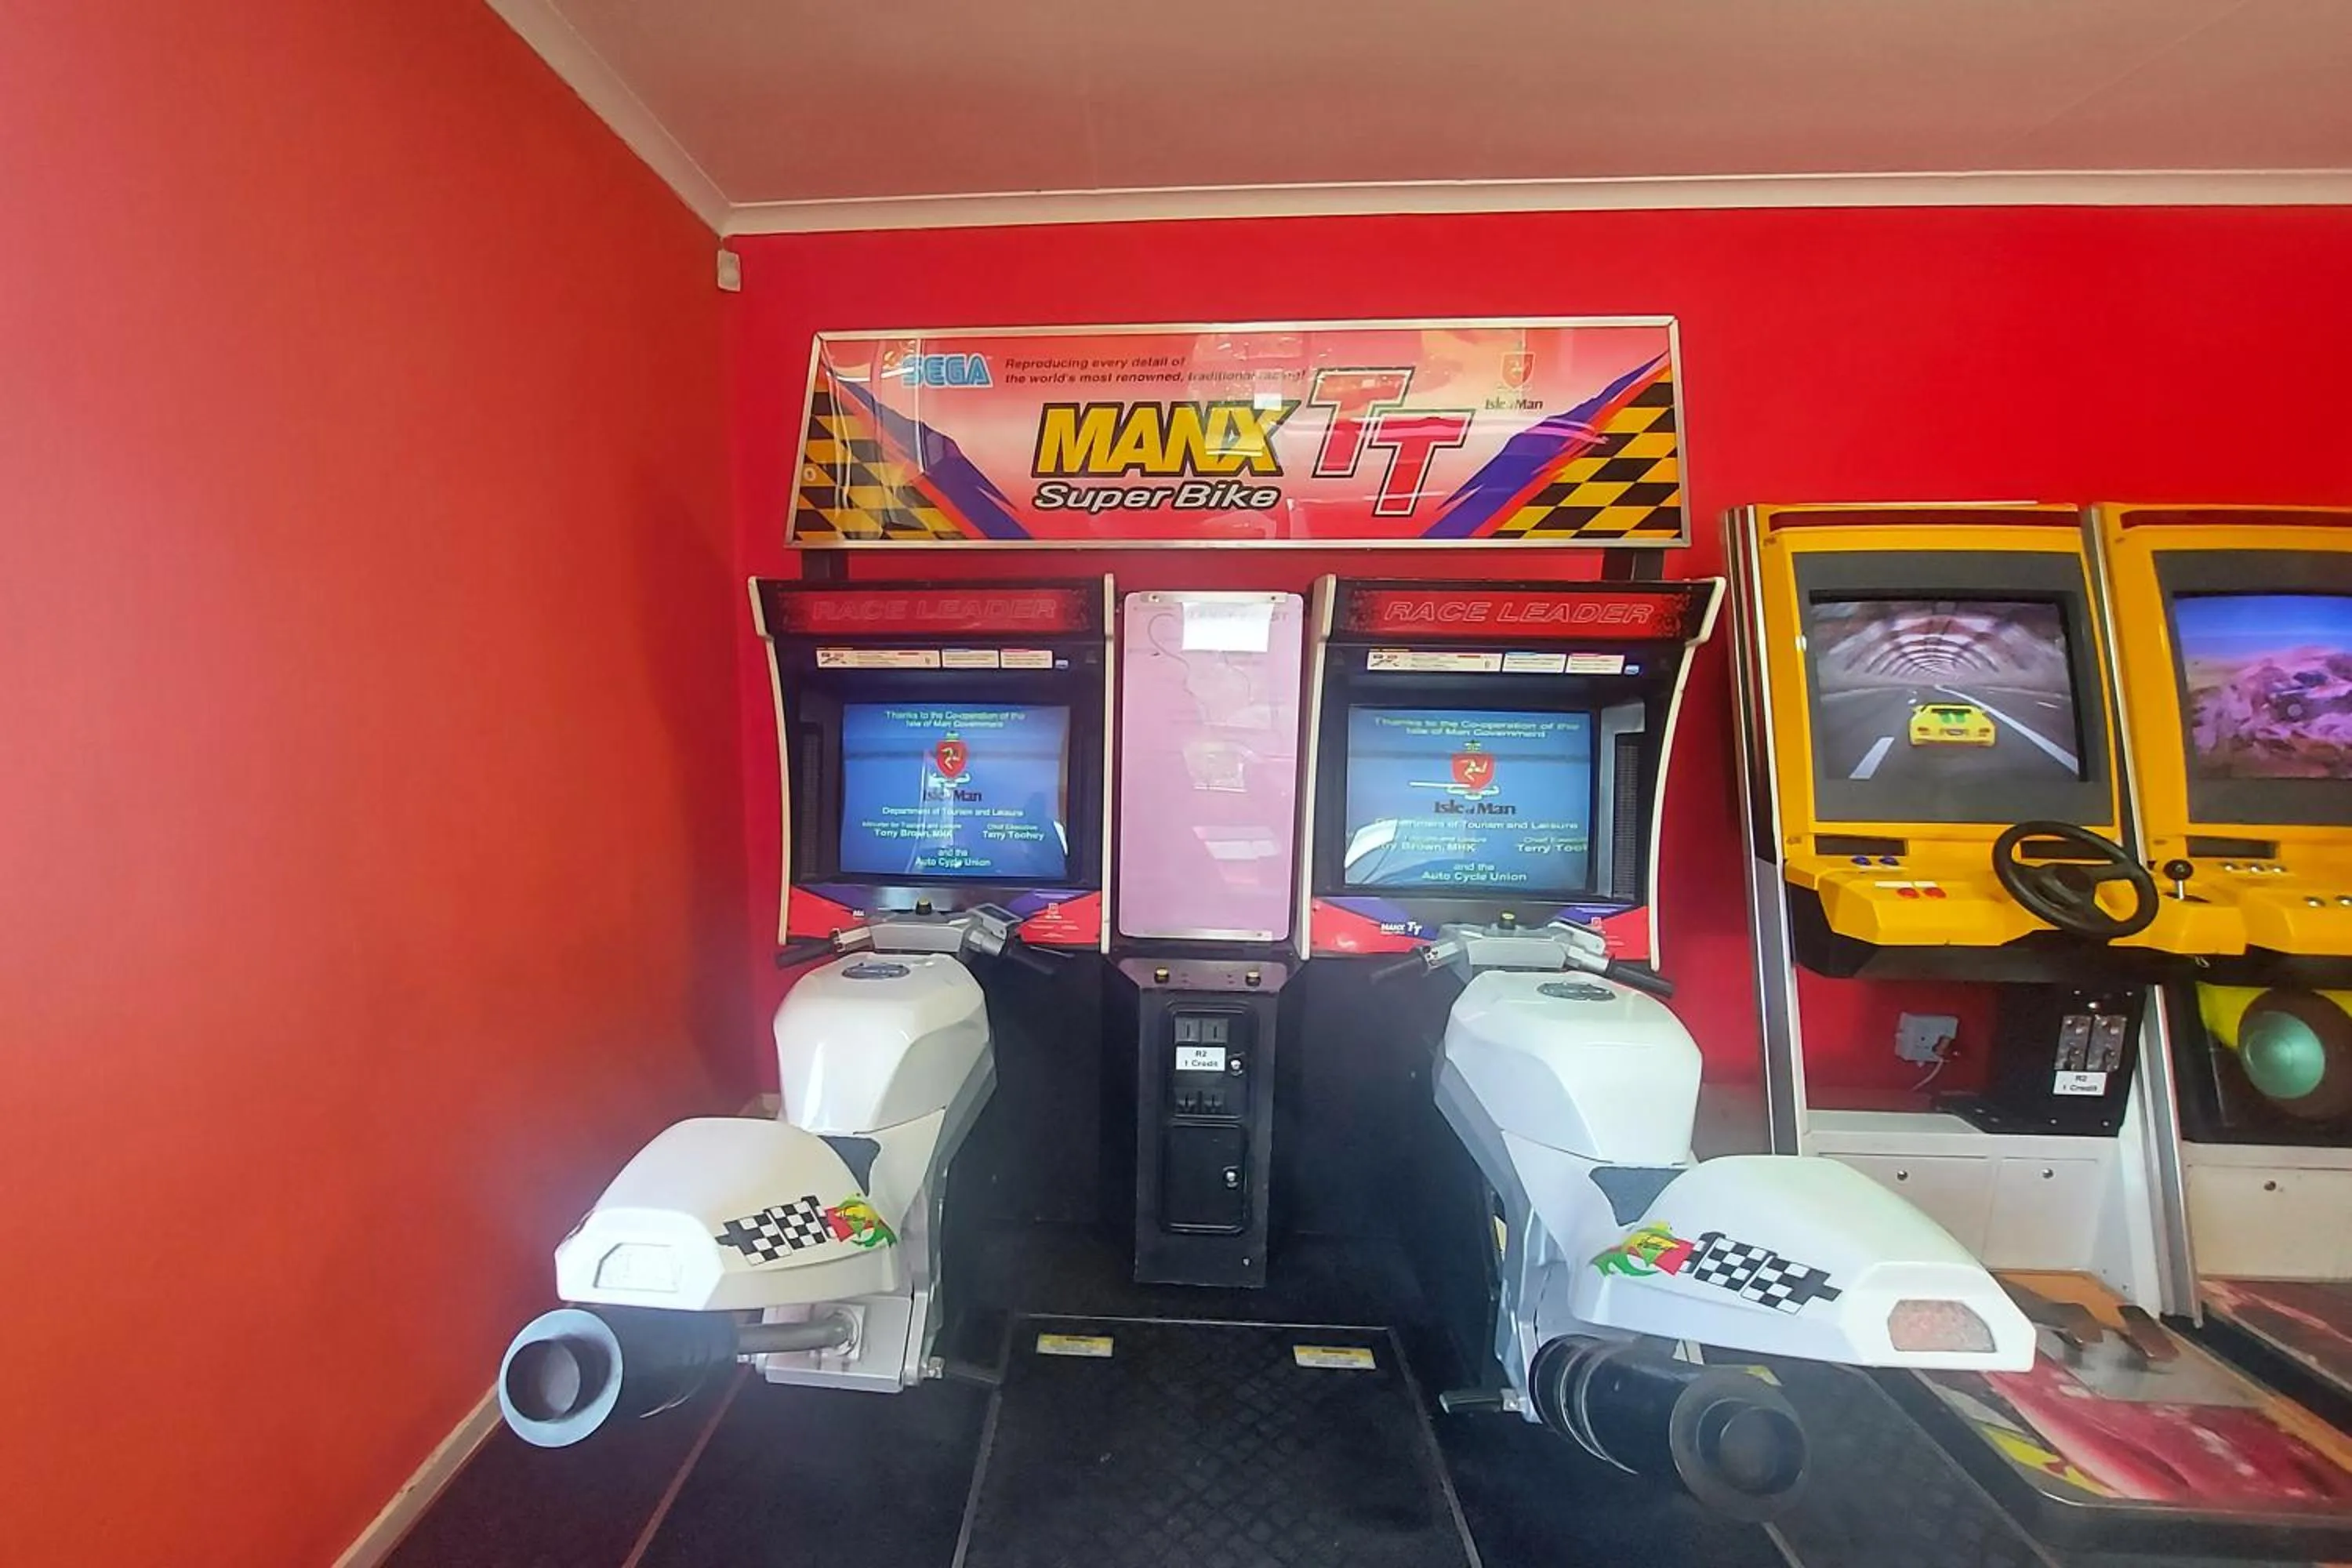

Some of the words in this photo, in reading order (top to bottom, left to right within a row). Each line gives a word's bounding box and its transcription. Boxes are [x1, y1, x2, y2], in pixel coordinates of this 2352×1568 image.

[902, 353, 993, 387] SEGA
[1005, 358, 1089, 372] Reproducing
[1092, 358, 1128, 370] every
[1131, 357, 1167, 368] detail
[1171, 356, 1186, 367] of
[1005, 374, 1026, 384] the
[1029, 372, 1076, 384] world's
[1080, 372, 1112, 383] most
[1116, 371, 1185, 383] renowned,
[1515, 398, 1544, 409] Man
[1032, 401, 1301, 477] MANX
[811, 599, 909, 620] RACE
[916, 598, 1058, 620] LEADER
[1384, 601, 1492, 622] RACE
[1497, 601, 1655, 625] LEADER
[953, 789, 982, 802] Man
[1434, 799, 1464, 814] Isle
[1477, 802, 1516, 815] Man
[1506, 821, 1528, 829] and
[1518, 843, 1552, 854] Terry
[916, 857, 937, 866] Auto
[964, 858, 992, 867] Union
[1454, 863, 1474, 872] and
[1477, 863, 1495, 872] the
[1421, 871, 1450, 880] Auto
[1454, 871, 1487, 883] Cycle
[1490, 873, 1527, 881] Union
